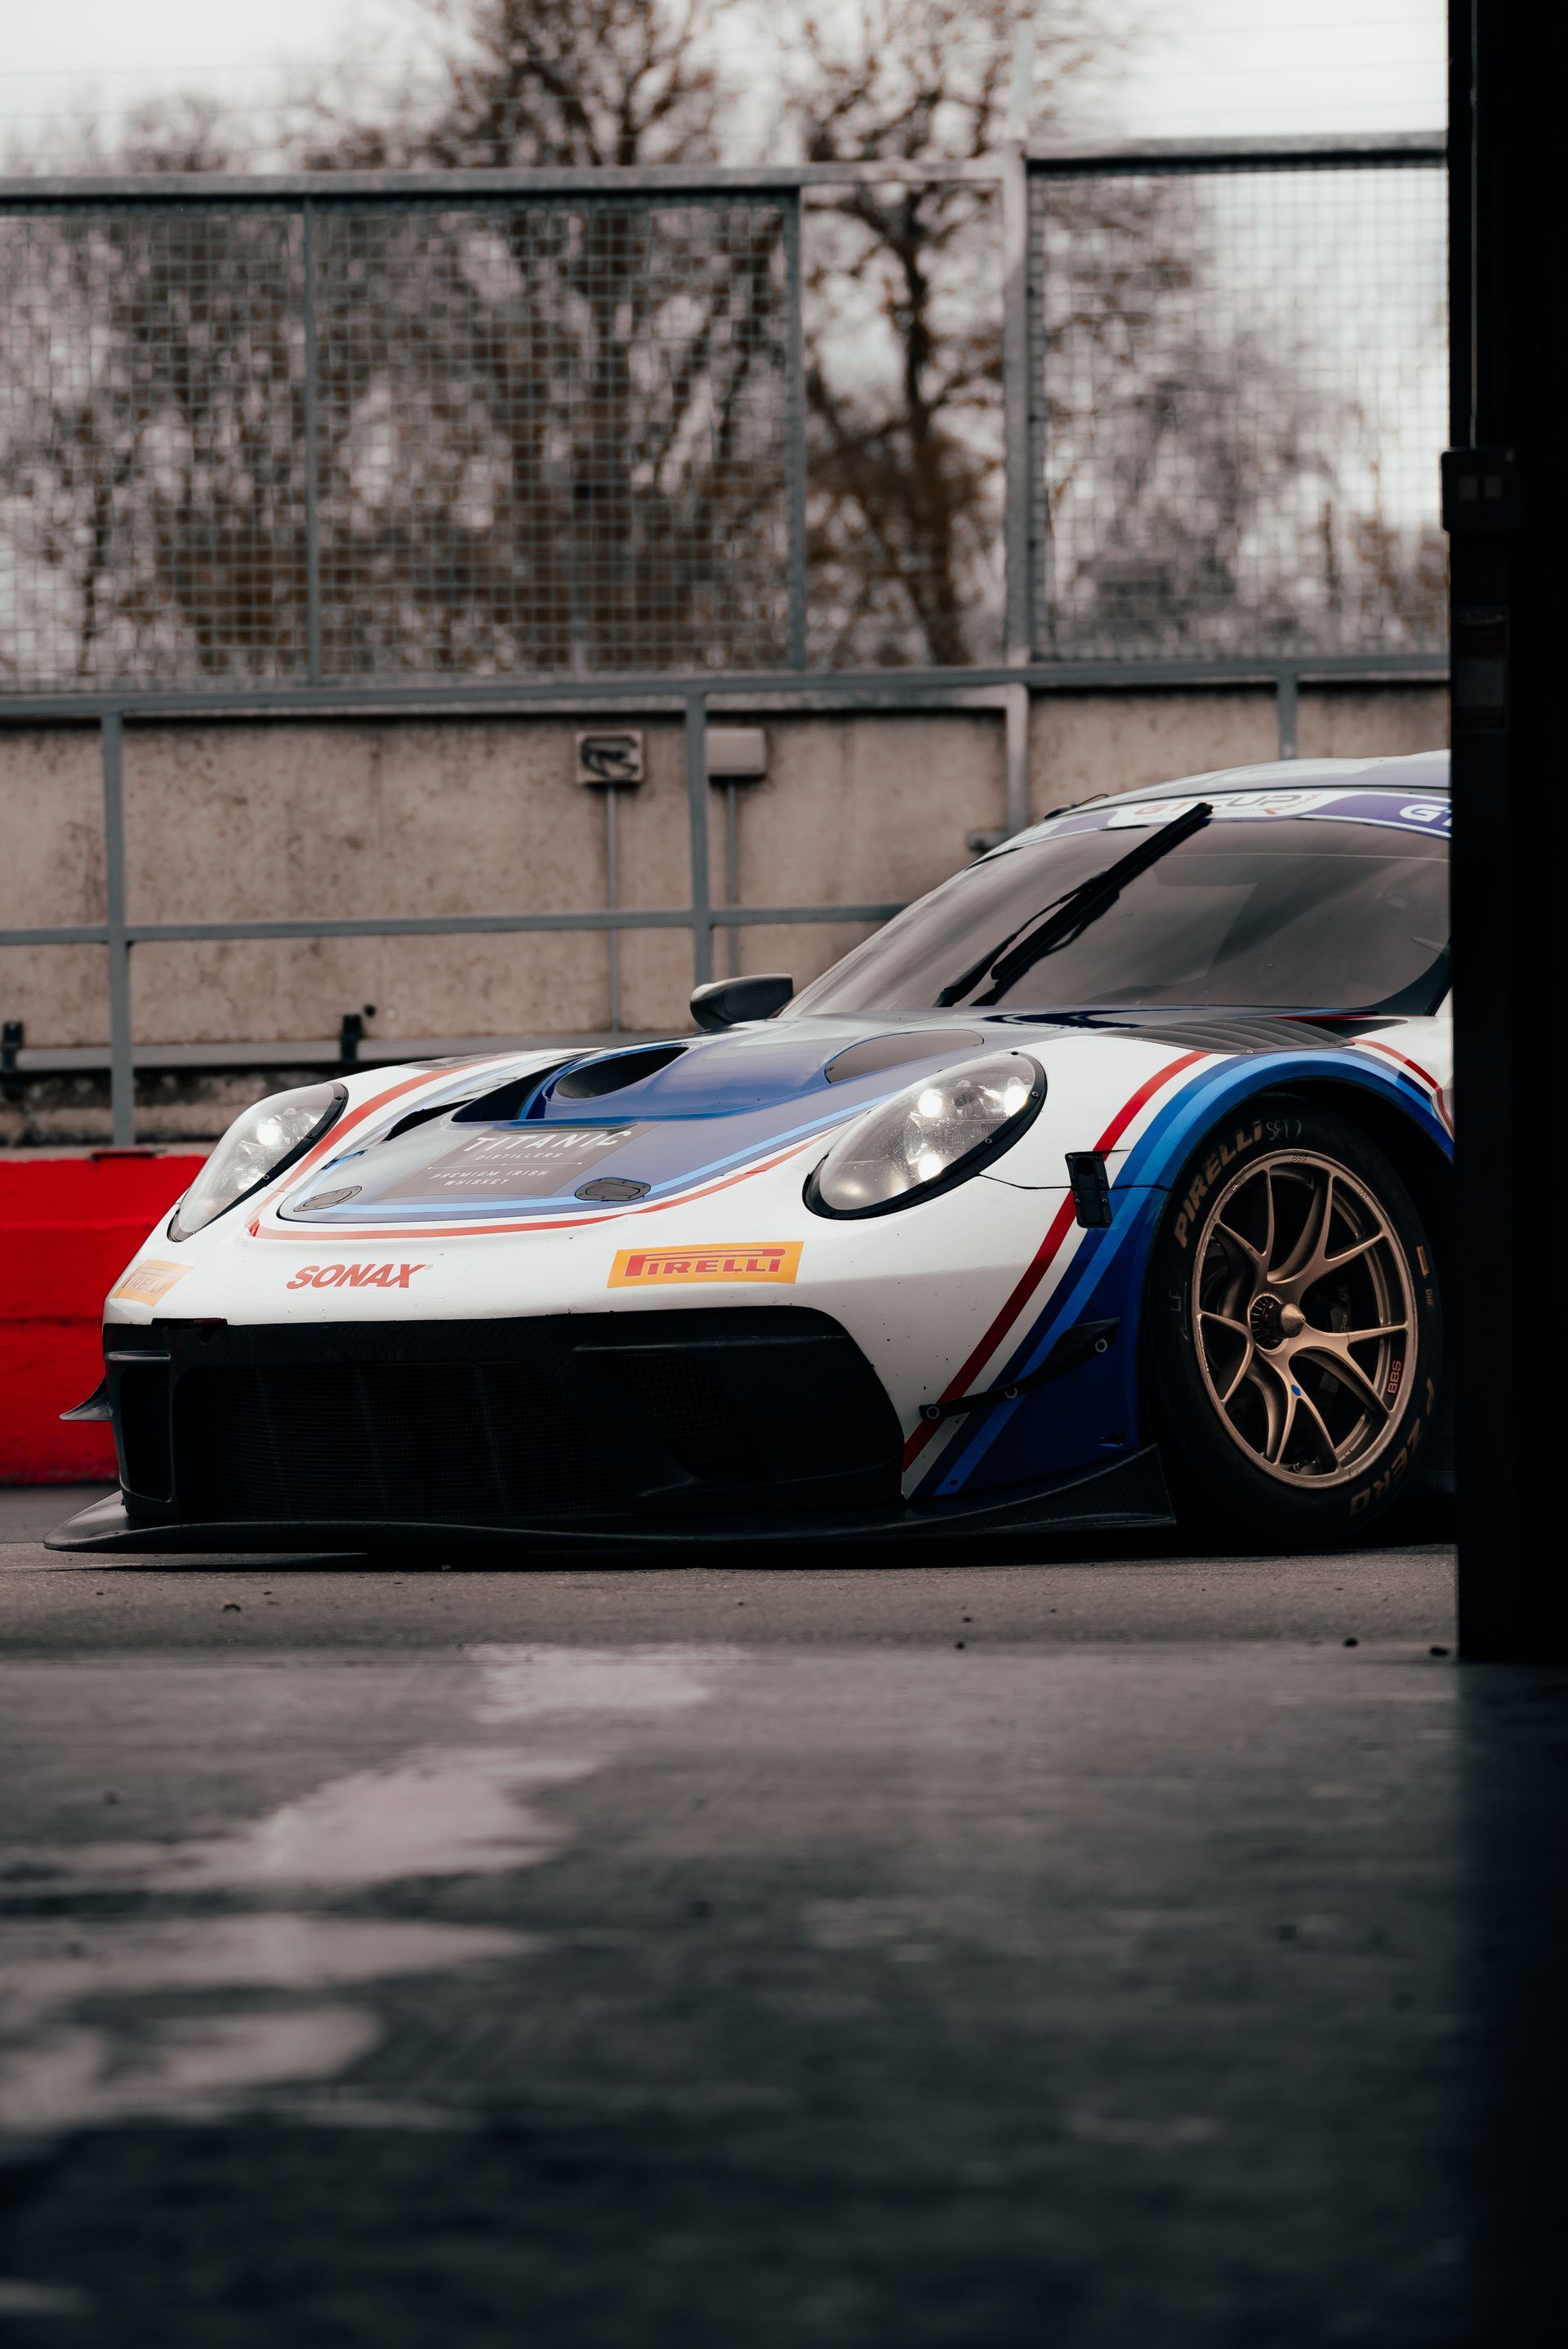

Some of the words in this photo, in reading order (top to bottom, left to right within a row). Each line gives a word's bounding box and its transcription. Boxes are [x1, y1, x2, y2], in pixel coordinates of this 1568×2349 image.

[463, 1130, 632, 1151] TITANIC
[475, 1152, 564, 1161] DISTILLERS
[430, 1170, 501, 1179] PREMIUM
[1174, 1117, 1263, 1250] PIRELLI
[624, 1248, 787, 1277] PIRELLI
[286, 1264, 427, 1289] SONAX
[1387, 1360, 1402, 1394] BBS
